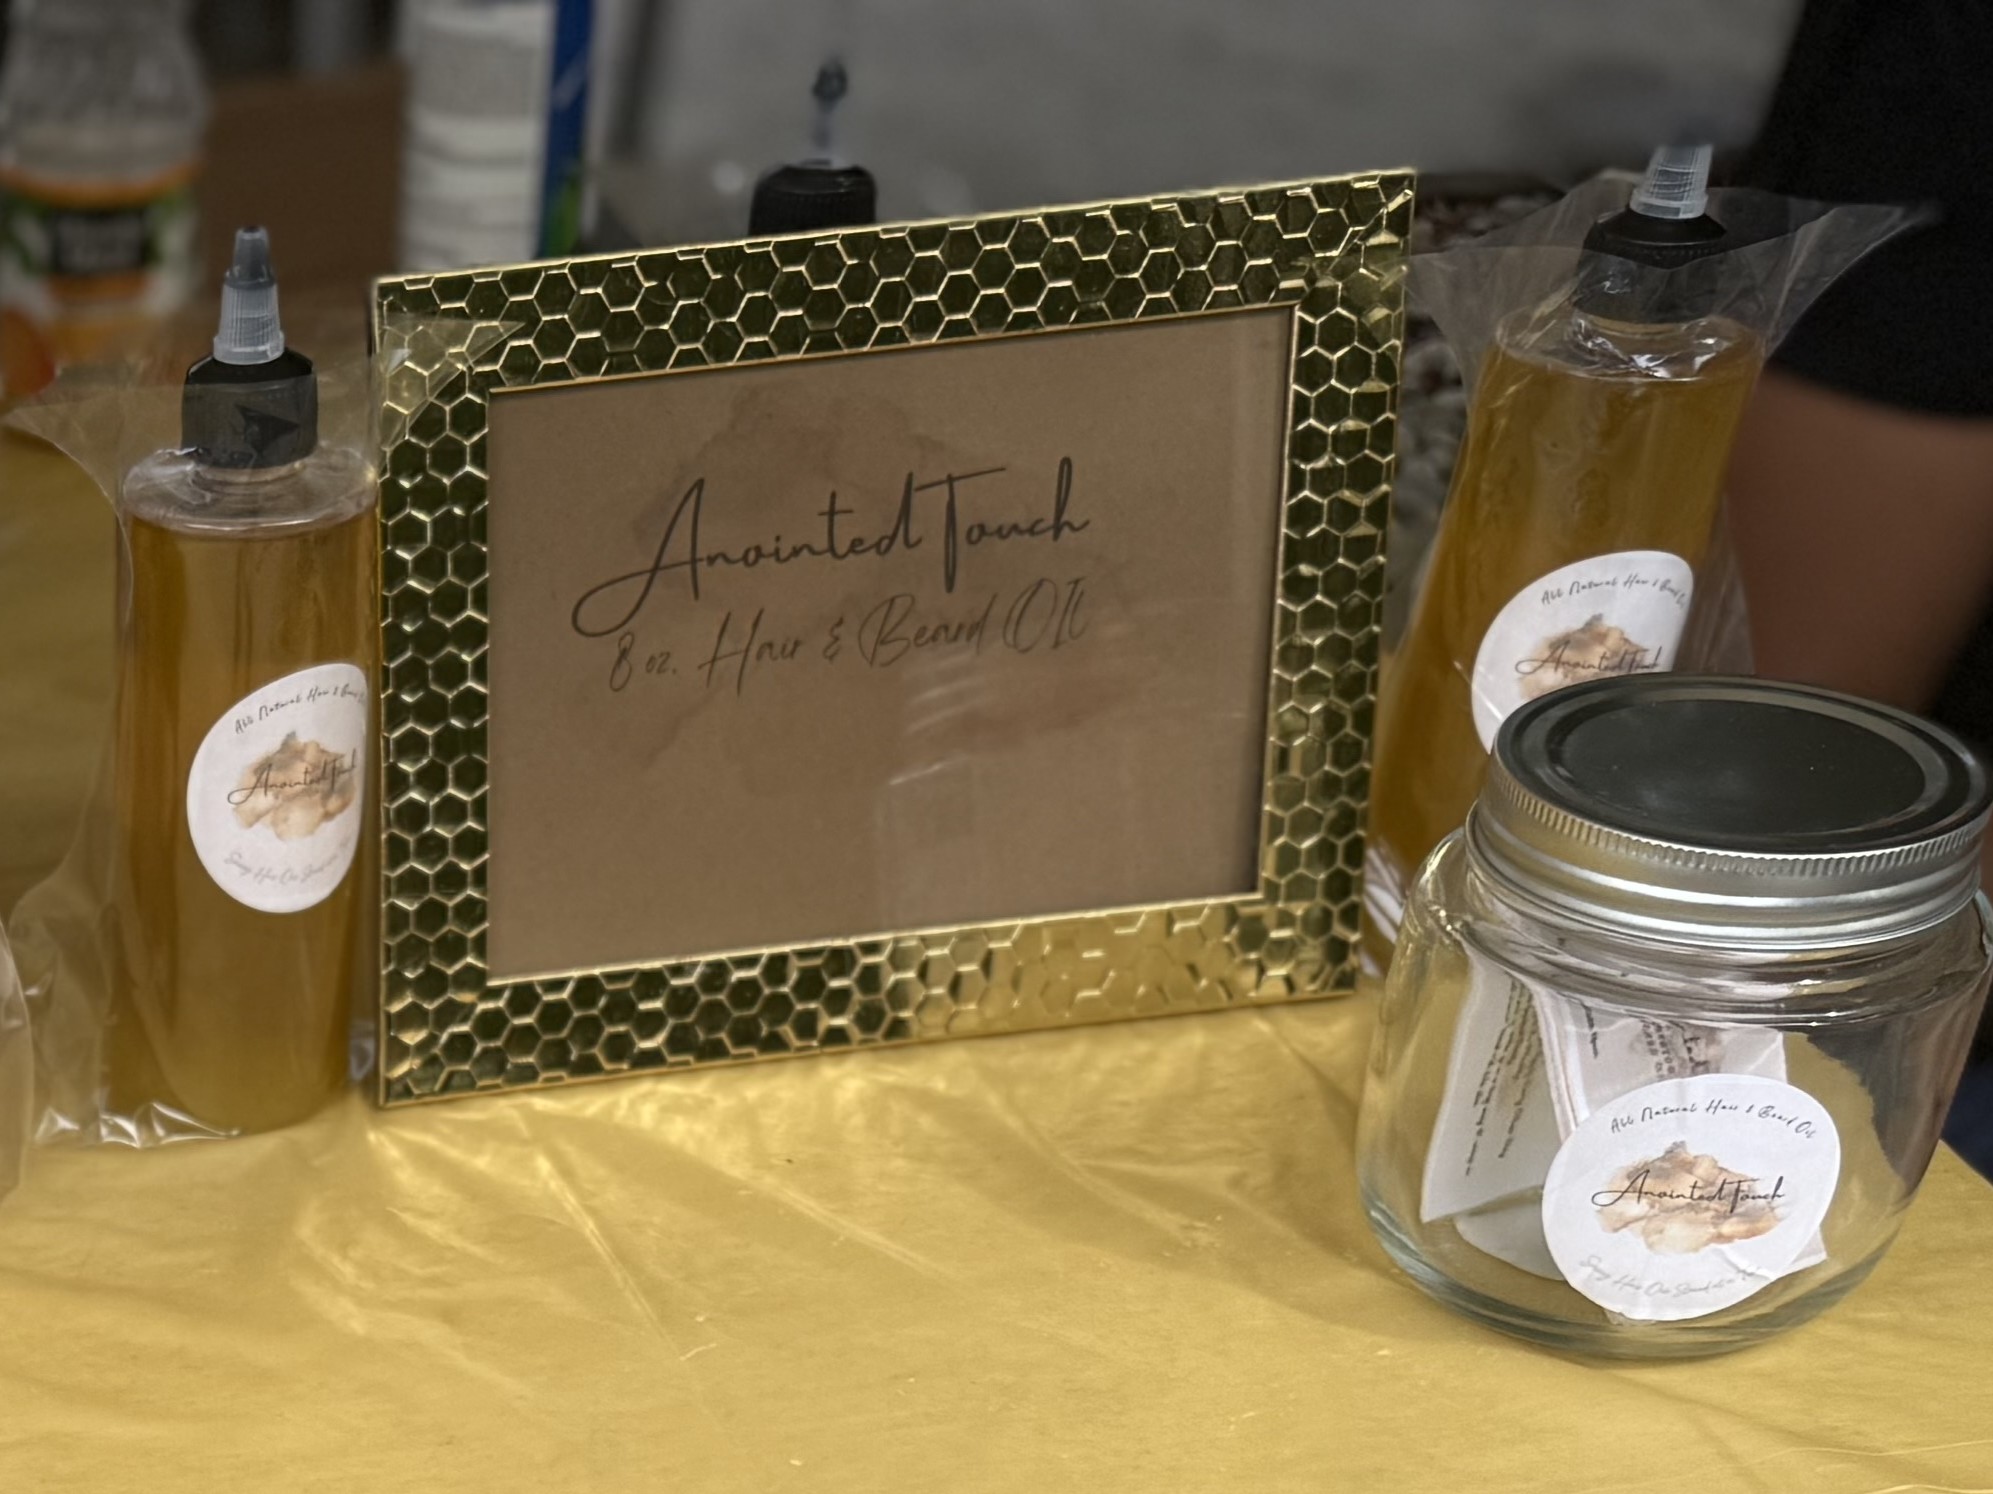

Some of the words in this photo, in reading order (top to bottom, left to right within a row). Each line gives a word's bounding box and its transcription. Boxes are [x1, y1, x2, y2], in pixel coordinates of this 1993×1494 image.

[608, 630, 635, 693] 8
[645, 652, 677, 676] oz.
[698, 607, 802, 697] Hair
[821, 615, 845, 663] &
[857, 592, 999, 668] Beard
